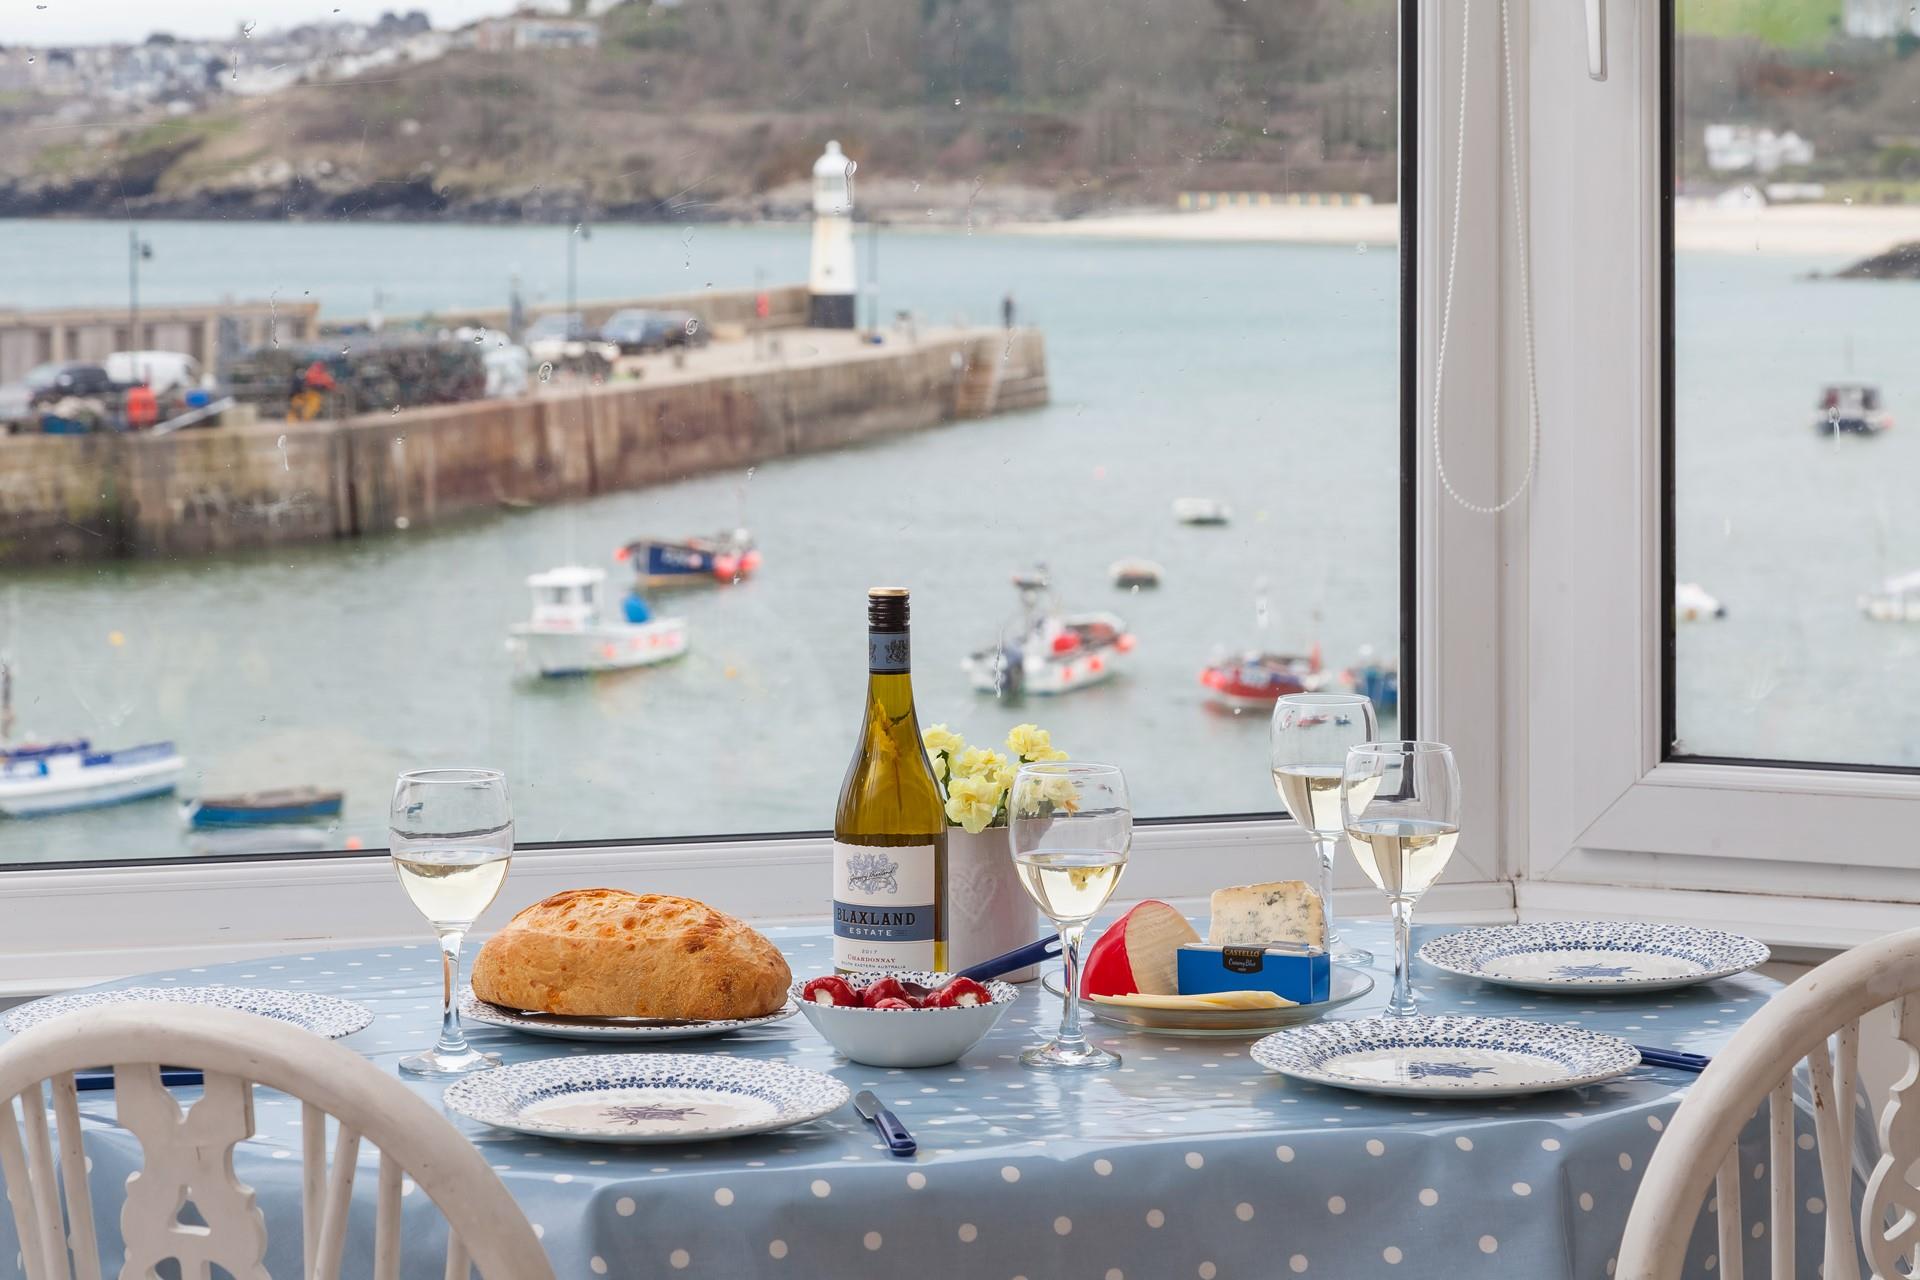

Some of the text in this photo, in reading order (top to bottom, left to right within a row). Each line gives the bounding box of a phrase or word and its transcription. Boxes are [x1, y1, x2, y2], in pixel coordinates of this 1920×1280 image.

[837, 907, 916, 926] BLAXLAND
[849, 927, 893, 937] ESTATE
[1224, 949, 1260, 957] CASTELLO
